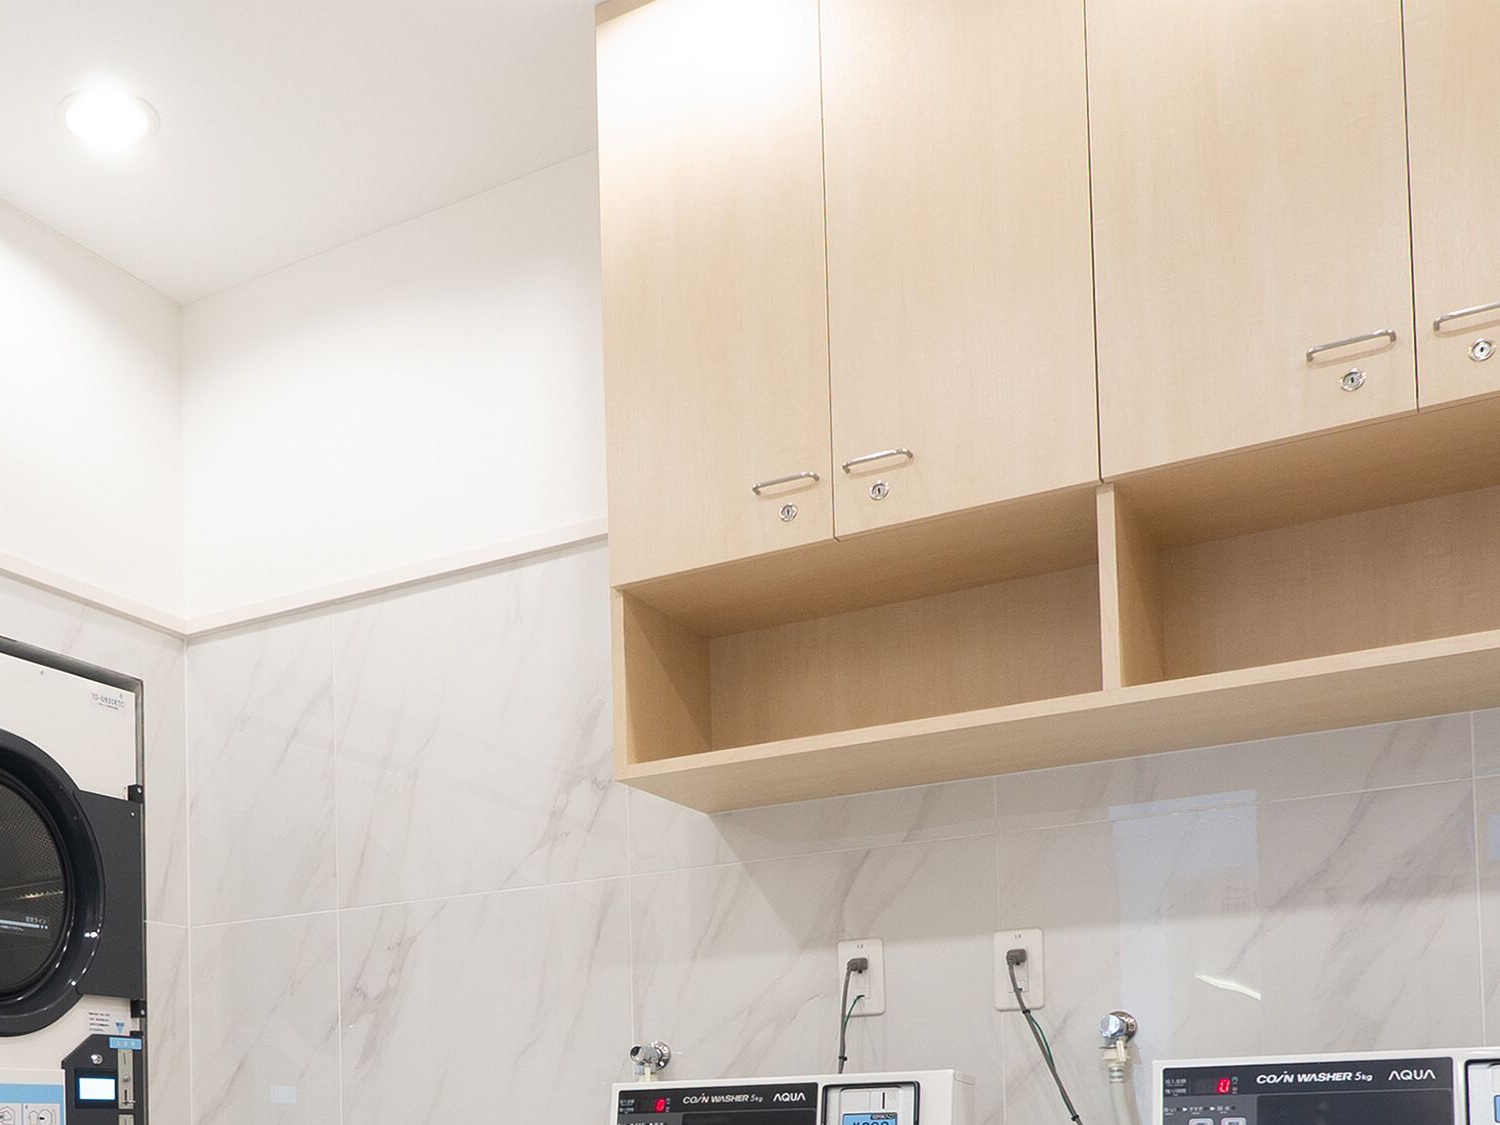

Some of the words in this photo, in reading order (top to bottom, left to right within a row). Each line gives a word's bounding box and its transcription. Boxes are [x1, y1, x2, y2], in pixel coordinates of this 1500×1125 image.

[1297, 1071, 1352, 1083] WASHER
[1354, 1071, 1373, 1082] 5kg
[1388, 1069, 1436, 1081] AQUA
[710, 1094, 749, 1103] WASHER
[772, 1092, 806, 1102] AQUA
